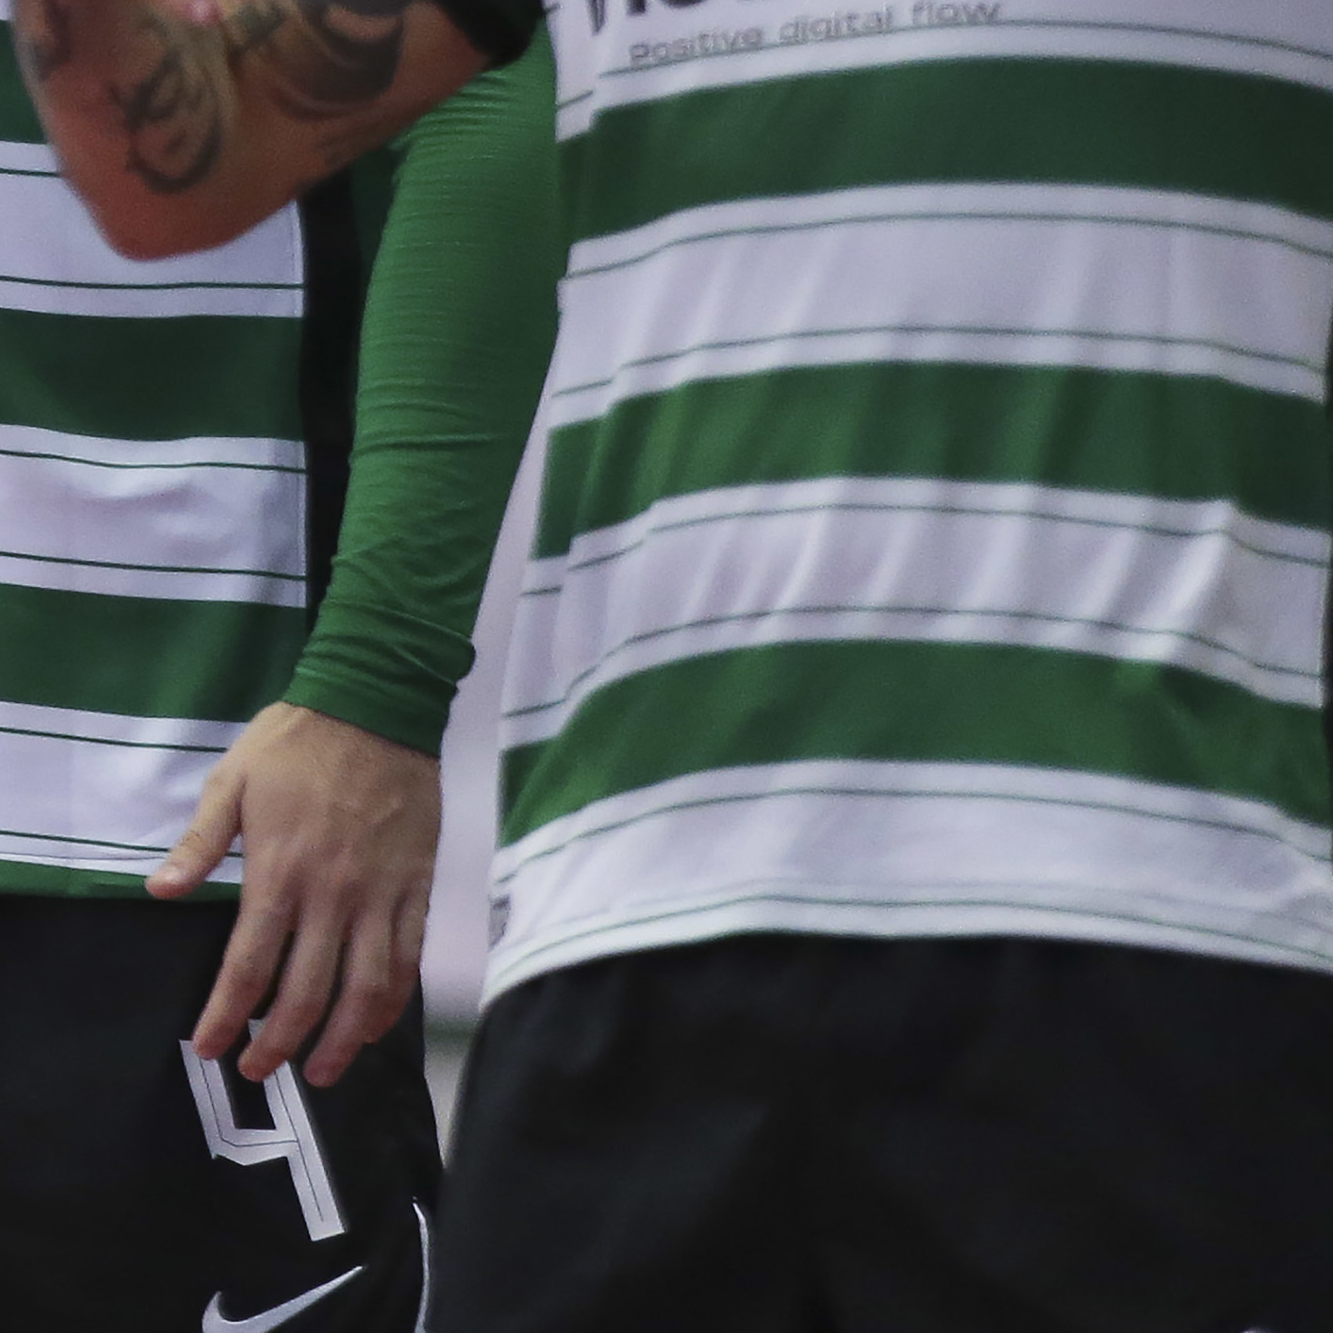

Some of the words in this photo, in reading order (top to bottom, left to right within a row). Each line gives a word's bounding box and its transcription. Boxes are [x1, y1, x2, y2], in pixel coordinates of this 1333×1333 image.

[628, 26, 763, 67] Positive
[779, 1, 894, 44] digital
[179, 1018, 345, 1242] 4
